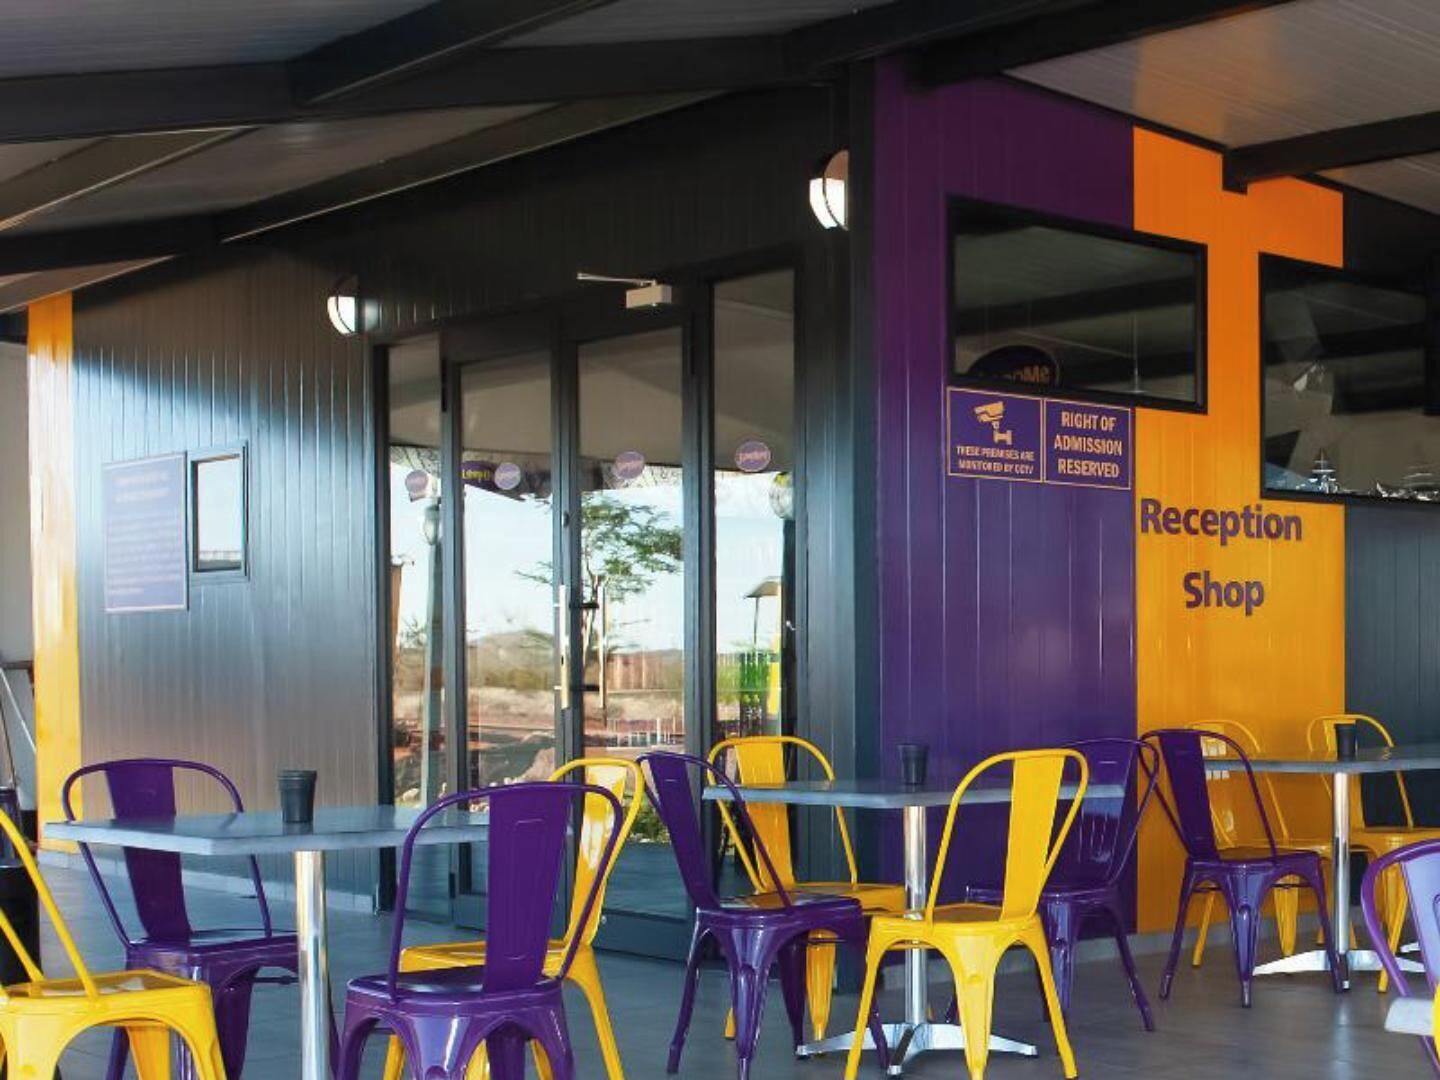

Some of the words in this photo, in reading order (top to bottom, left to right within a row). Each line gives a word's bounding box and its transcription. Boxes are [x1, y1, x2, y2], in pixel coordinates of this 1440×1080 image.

[1061, 411, 1099, 430] RIGHT
[1101, 415, 1117, 432] OF
[1054, 433, 1122, 457] ADMISSION
[1058, 458, 1120, 478] RESERVED
[1140, 498, 1302, 546] Reception
[1184, 571, 1265, 616] Shop
